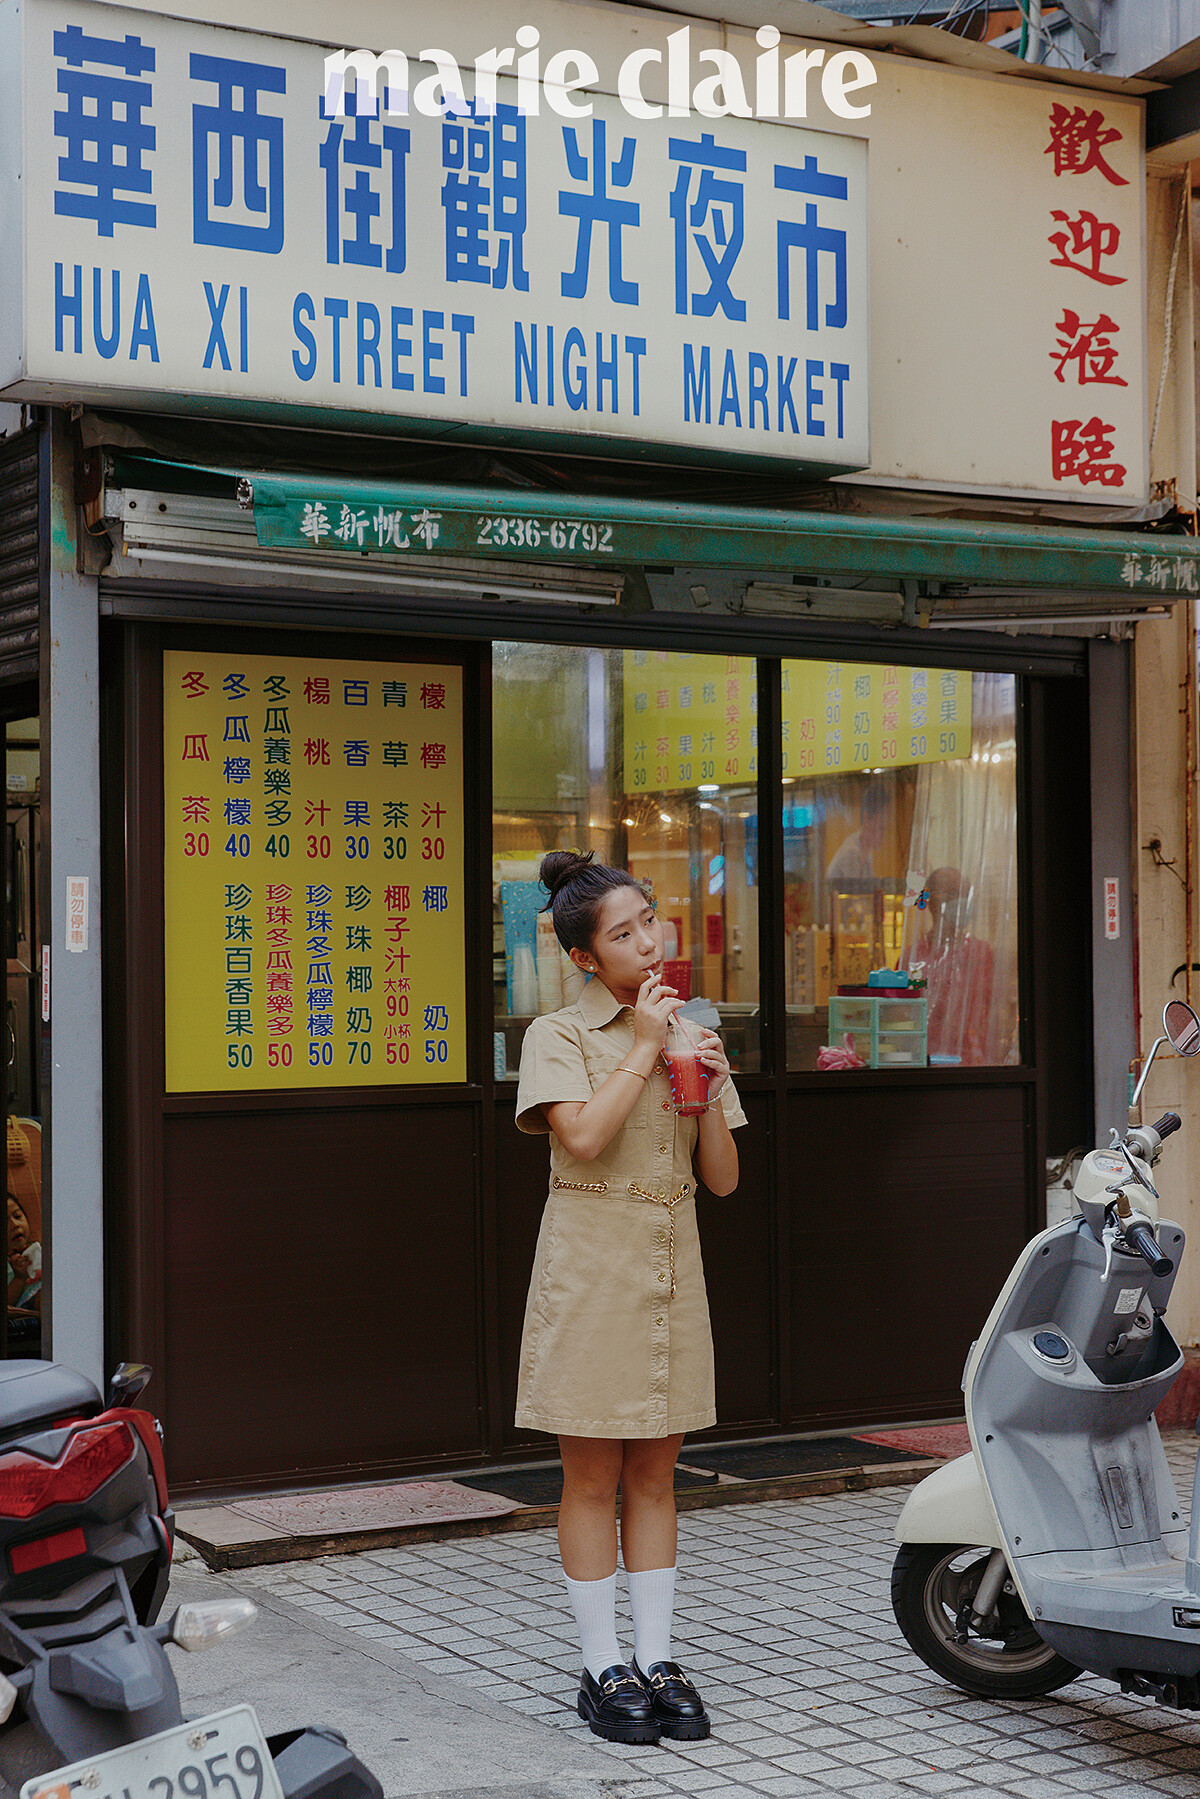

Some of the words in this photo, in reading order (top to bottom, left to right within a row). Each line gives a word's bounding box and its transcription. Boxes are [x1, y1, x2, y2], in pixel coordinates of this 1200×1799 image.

[53, 24, 848, 331] 華西街觀光夜市
[1044, 102, 1130, 487] 歡迎蒞臨
[54, 262, 160, 364] HUA
[202, 281, 248, 374] XI
[291, 292, 475, 397] STREET
[514, 320, 647, 417] NIGHT
[683, 342, 850, 439] MARKET
[299, 501, 443, 550] 華新帆布
[476, 516, 614, 552] 2336-6792
[826, 704, 841, 725] 90
[181, 671, 210, 824] 冬瓜茶
[222, 673, 251, 826] 冬瓜檸檬
[263, 675, 292, 827] 冬瓜養樂多
[303, 677, 331, 826] 楊桃汁
[342, 680, 371, 827] 百香果
[381, 680, 409, 828] 青草茶
[854, 742, 869, 762] 70
[882, 739, 897, 760] 50
[911, 735, 926, 757] 50
[939, 732, 956, 753] 50
[420, 682, 447, 829] 檬檸汁
[725, 757, 739, 776] 40
[800, 748, 814, 768] 50
[826, 746, 841, 766] 50
[634, 768, 646, 786] 30
[656, 765, 669, 783] 30
[679, 762, 692, 781] 30
[701, 760, 715, 779] 30
[184, 832, 209, 857] 30
[225, 833, 251, 857] 40
[265, 834, 290, 858] 40
[306, 835, 331, 859] 30
[345, 836, 369, 859] 30
[383, 836, 407, 860] 30
[421, 837, 445, 860] 30
[384, 885, 411, 974] 椰子汁
[224, 883, 254, 1037] 珍珠百香果
[265, 883, 294, 1037] 珍珠冬瓜養樂多
[305, 884, 334, 1037] 珍珠冬瓜檸檬
[345, 884, 372, 1034] 珍珠椰奶
[422, 885, 449, 1032] 椰奶
[383, 977, 411, 994] 大杯
[386, 995, 409, 1017] 90
[383, 1024, 411, 1039] 小杯
[227, 1044, 253, 1068] 50
[268, 1042, 293, 1068] 50
[308, 1041, 333, 1066] 50
[347, 1041, 371, 1065] 70
[386, 1042, 410, 1065] 50
[425, 1039, 448, 1063] 50
